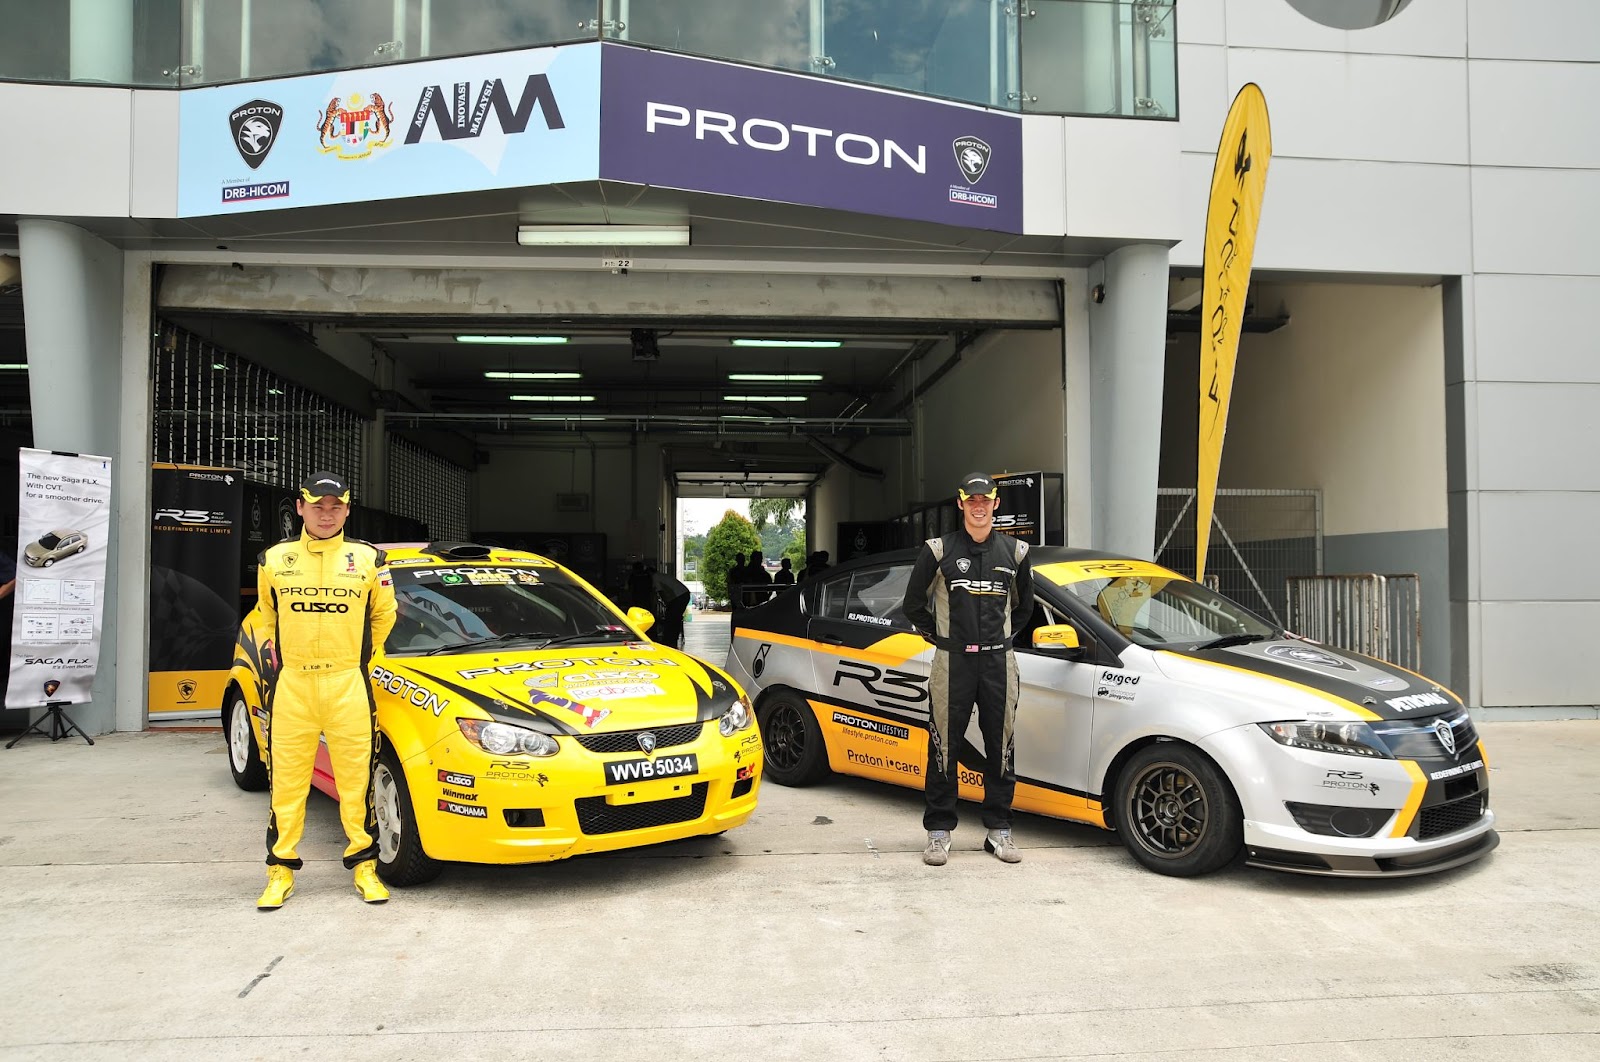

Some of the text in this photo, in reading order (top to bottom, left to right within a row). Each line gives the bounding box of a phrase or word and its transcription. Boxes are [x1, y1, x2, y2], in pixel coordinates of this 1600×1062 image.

[414, 85, 435, 128] AGENSI
[457, 81, 466, 129] INOVASI
[469, 79, 496, 135] MALAYSIA
[231, 106, 281, 121] PROTON
[646, 101, 926, 175] PROTON
[955, 140, 989, 153] PROTON
[224, 183, 287, 200] DRB-HICOM
[951, 191, 995, 205] DRB-HICOM
[27, 472, 41, 480] The
[61, 476, 81, 484] Saga
[82, 478, 100, 486] FLX.
[189, 472, 224, 480] PROTON
[45, 494, 81, 502] smoother
[83, 496, 104, 504] drive.
[154, 508, 210, 523] R3
[153, 525, 194, 533] REDEFINING
[412, 567, 541, 579] PROTON
[279, 587, 362, 599] PROTON
[290, 602, 349, 614] CUSCO
[848, 612, 892, 626] R3.PROTON.COM
[457, 657, 680, 680] PROTON
[562, 671, 661, 683] CUSCO
[833, 659, 929, 703] R3
[1101, 670, 1141, 686] forged
[368, 664, 450, 717] PROTON
[572, 685, 658, 700] Redberry
[833, 712, 908, 739] PROTON LIFESTYLE
[842, 726, 899, 747] lifestyle.proton.com
[846, 748, 883, 767] Proton
[489, 760, 531, 770] R3
[610, 756, 693, 782] WVB 5034
[446, 776, 473, 787] CUSCO
[485, 771, 535, 779] PROTON
[1326, 769, 1364, 780] R3
[1323, 780, 1368, 789] PROTON
[448, 803, 487, 817] YOKOHAMA
